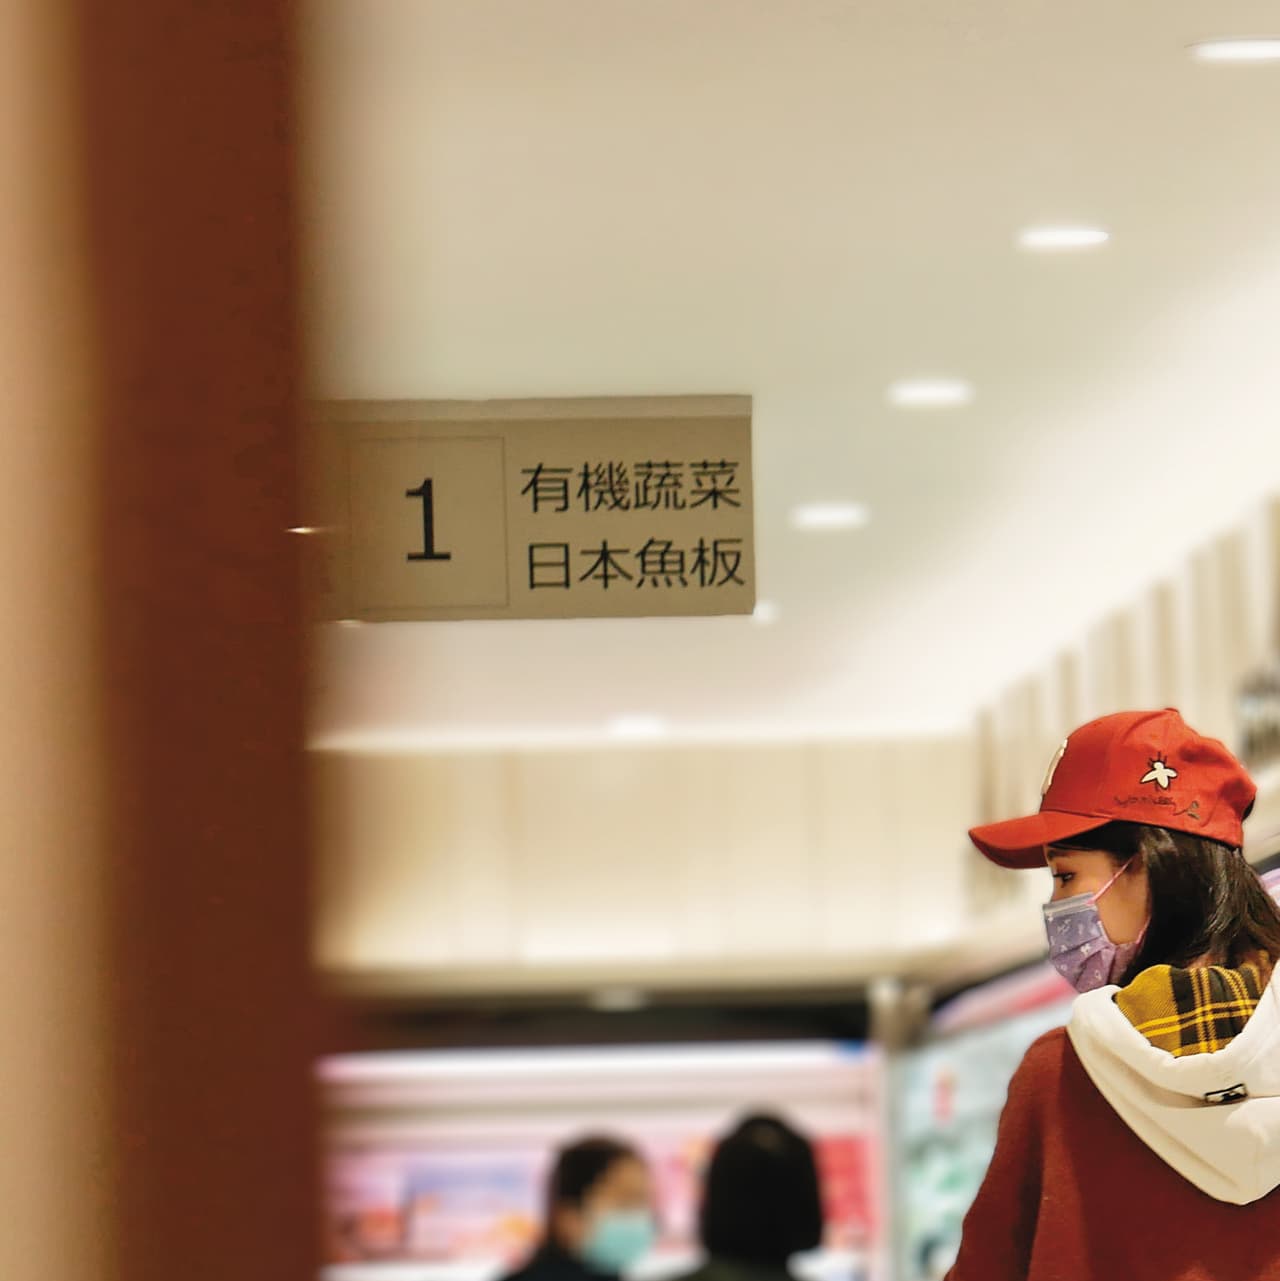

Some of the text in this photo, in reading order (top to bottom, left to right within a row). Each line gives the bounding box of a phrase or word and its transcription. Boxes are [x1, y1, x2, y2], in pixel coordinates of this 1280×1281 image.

[520, 459, 742, 514] 有機蔬菜
[405, 477, 452, 563] 1
[527, 536, 745, 591] 日本魚板
